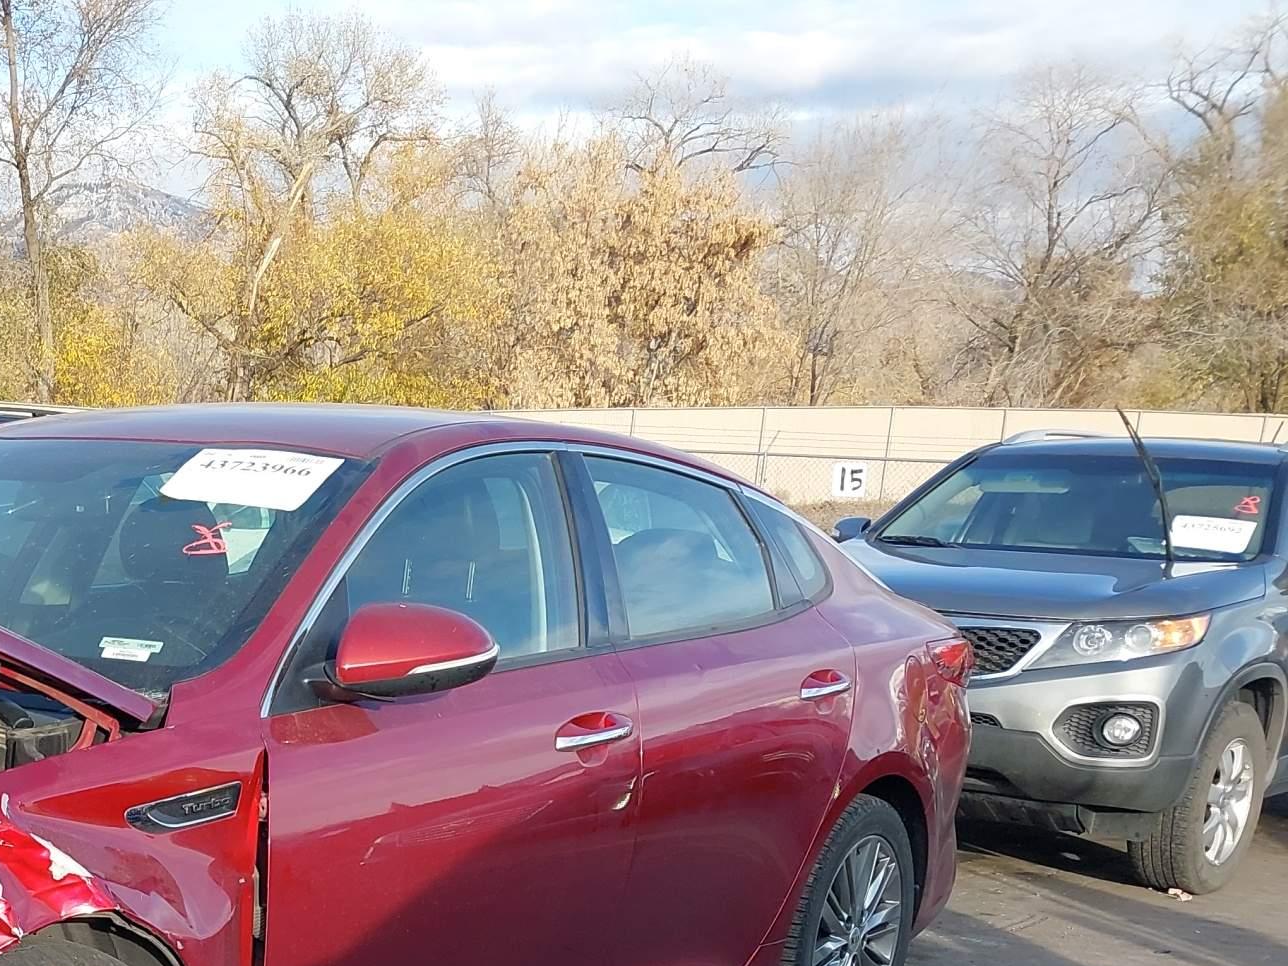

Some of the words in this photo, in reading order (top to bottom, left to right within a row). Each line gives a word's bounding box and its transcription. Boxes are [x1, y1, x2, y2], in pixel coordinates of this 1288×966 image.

[200, 458, 312, 477] 43723966
[840, 467, 864, 491] 15
[182, 797, 232, 815] Turbo
